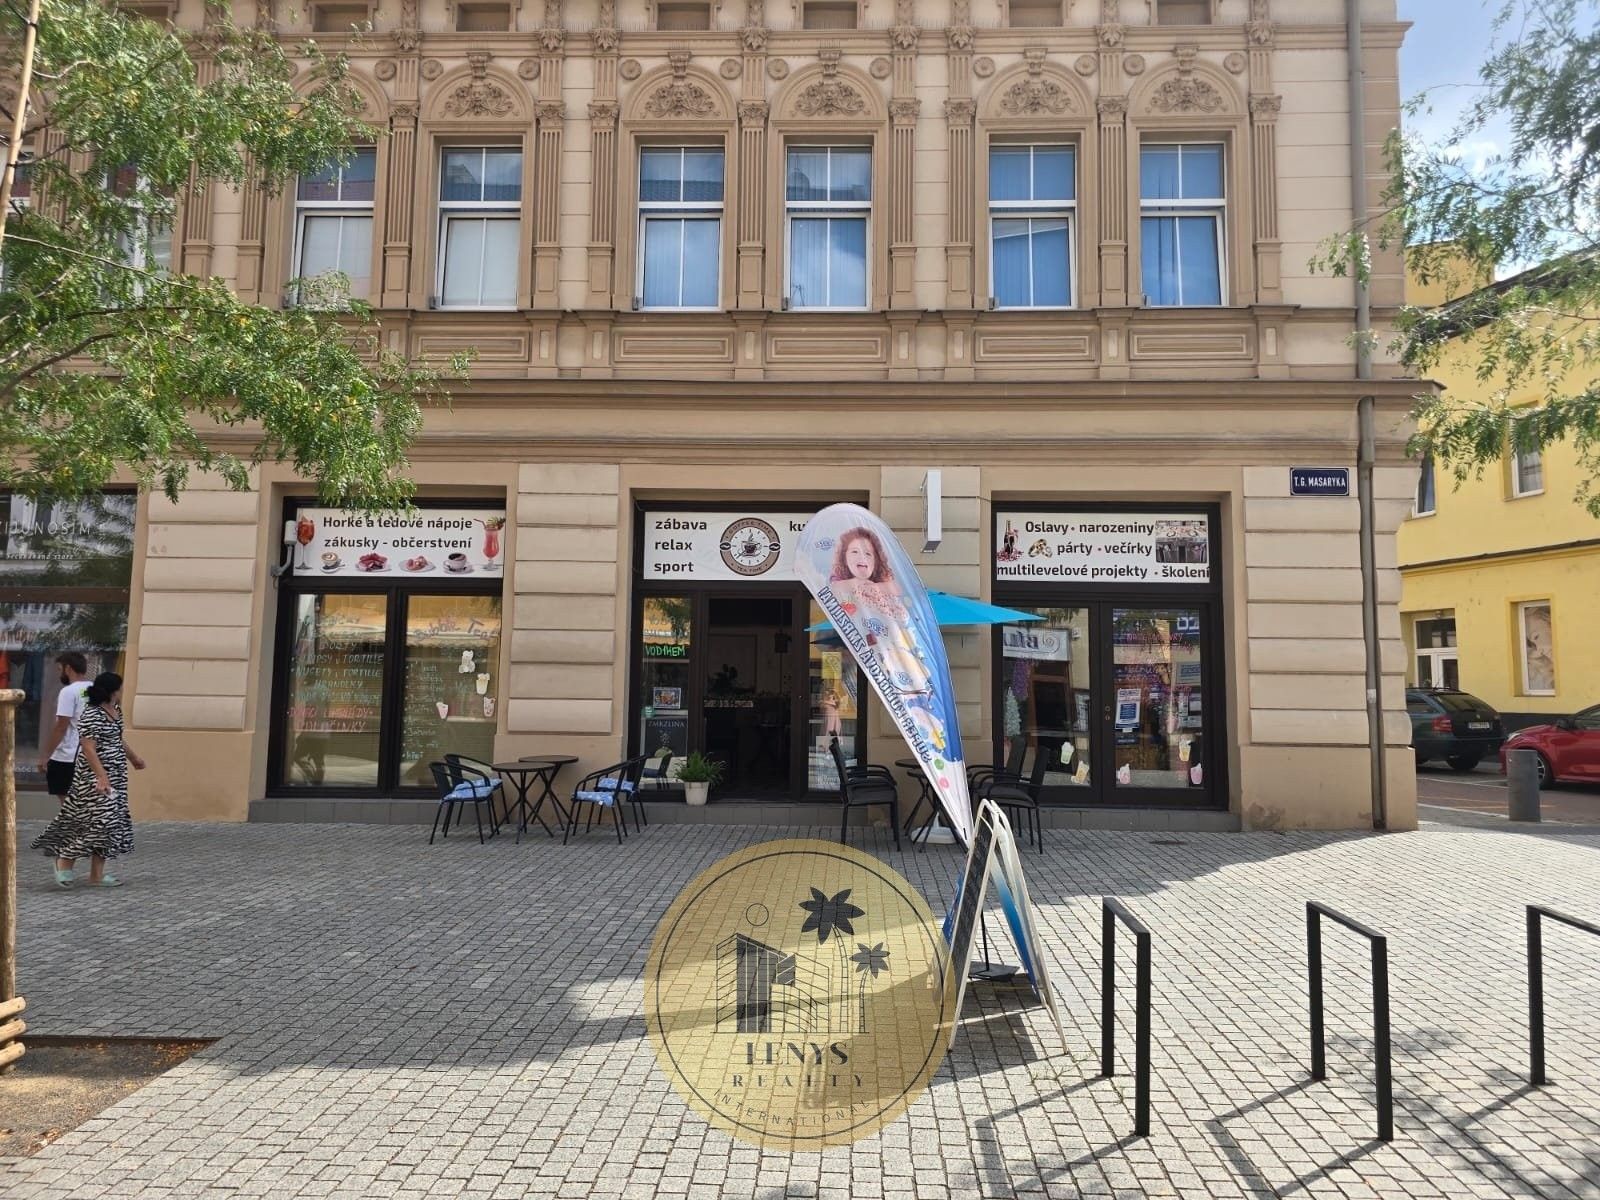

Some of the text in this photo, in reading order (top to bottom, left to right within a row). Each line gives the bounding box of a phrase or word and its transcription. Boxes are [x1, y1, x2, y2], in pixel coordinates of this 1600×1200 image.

[1308, 476, 1346, 487] MASARYKA
[323, 516, 362, 528] Horké
[366, 519, 374, 528] a
[427, 516, 473, 531] nápoje
[655, 518, 707, 531] zábava
[1025, 521, 1154, 536] Oslavy narozeniny
[324, 536, 379, 550] zákusky
[392, 536, 472, 548] občerstvení
[655, 539, 693, 550] relax
[1057, 541, 1153, 556] párty večírky
[654, 561, 695, 574] sport
[997, 564, 1210, 579] multilevelové projekty školení
